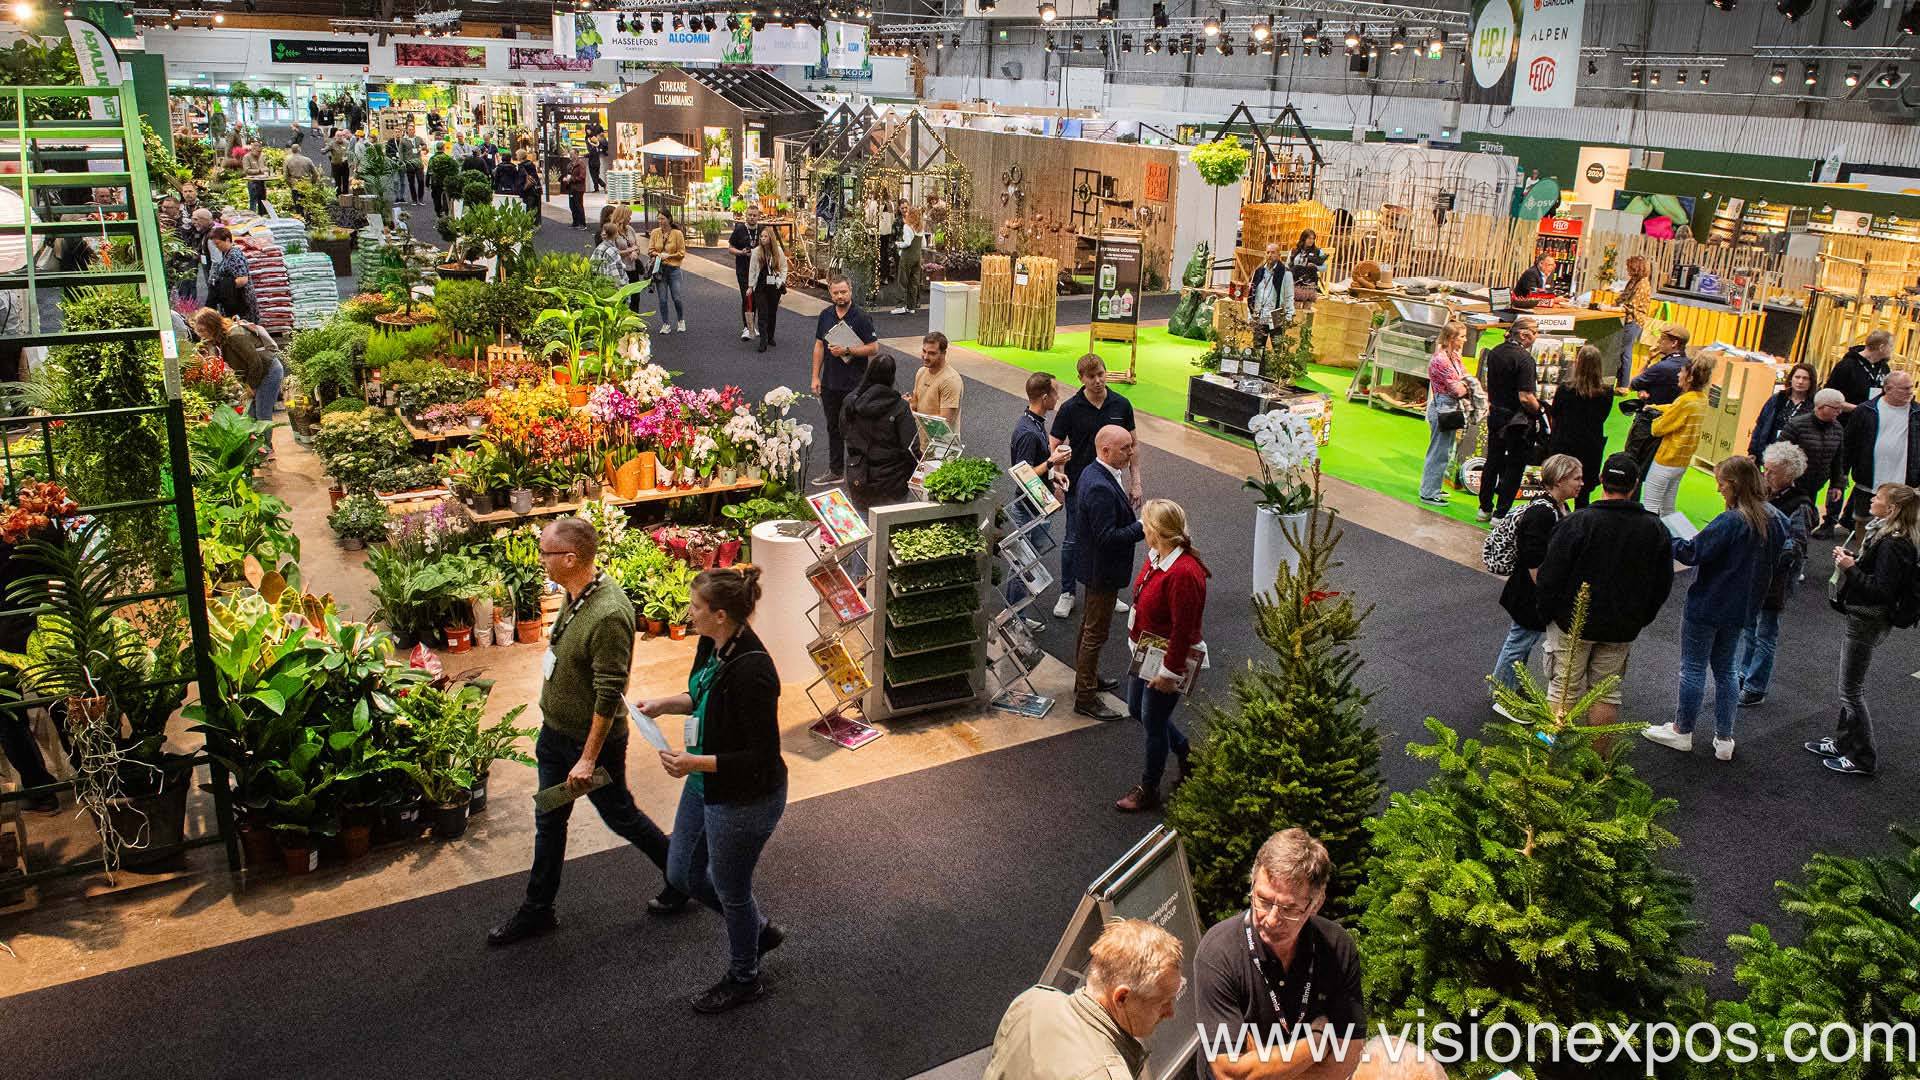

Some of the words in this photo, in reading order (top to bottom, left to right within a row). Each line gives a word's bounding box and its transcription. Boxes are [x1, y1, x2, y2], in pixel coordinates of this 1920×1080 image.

[612, 37, 658, 46] HASSELFORS
[669, 32, 710, 44] ALGOMIN
[1478, 26, 1507, 58] HPJ
[1528, 60, 1556, 92] FELCO
[659, 81, 688, 93] STARKARE
[1479, 141, 1504, 153] Elmia
